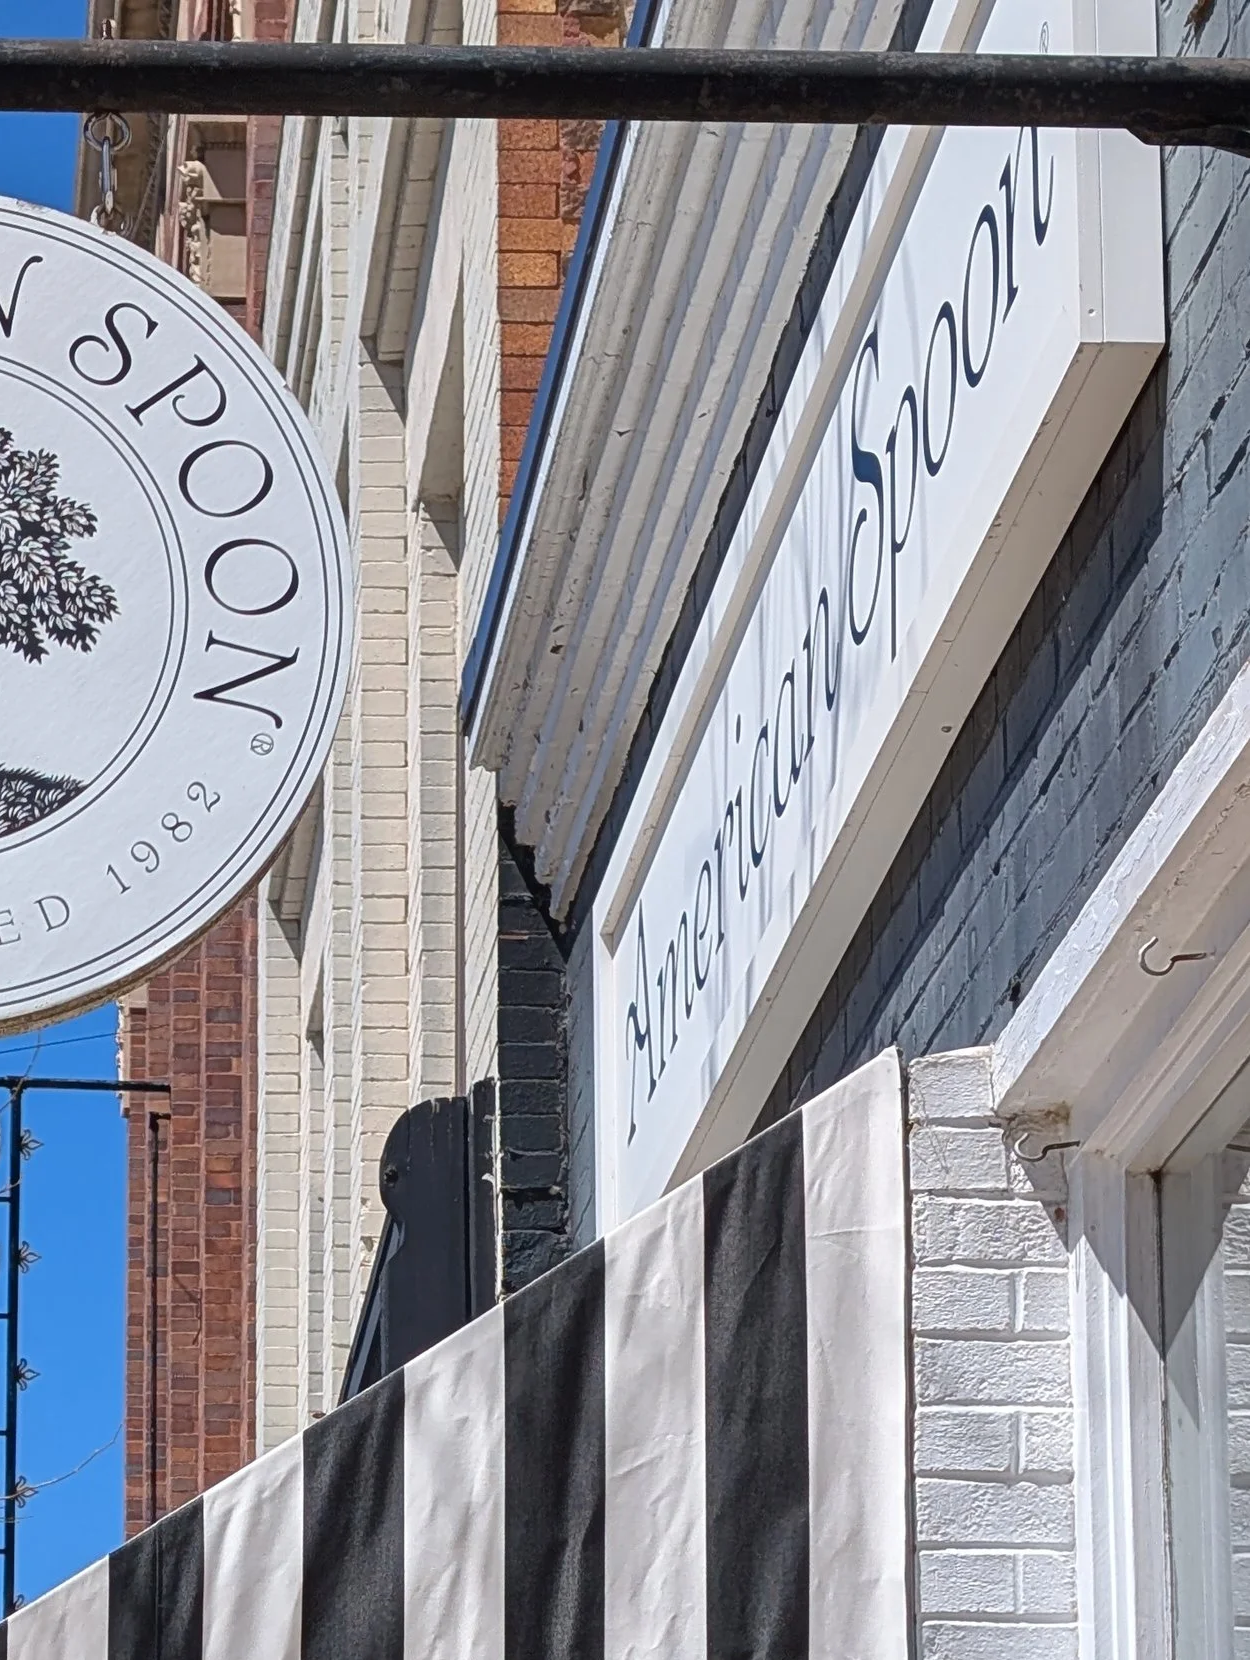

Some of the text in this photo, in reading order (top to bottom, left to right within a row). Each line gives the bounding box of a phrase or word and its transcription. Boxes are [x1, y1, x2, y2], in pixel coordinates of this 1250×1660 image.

[70, 302, 300, 729] SPOON
[107, 780, 221, 895] 1982
[626, 586, 840, 1135] American
